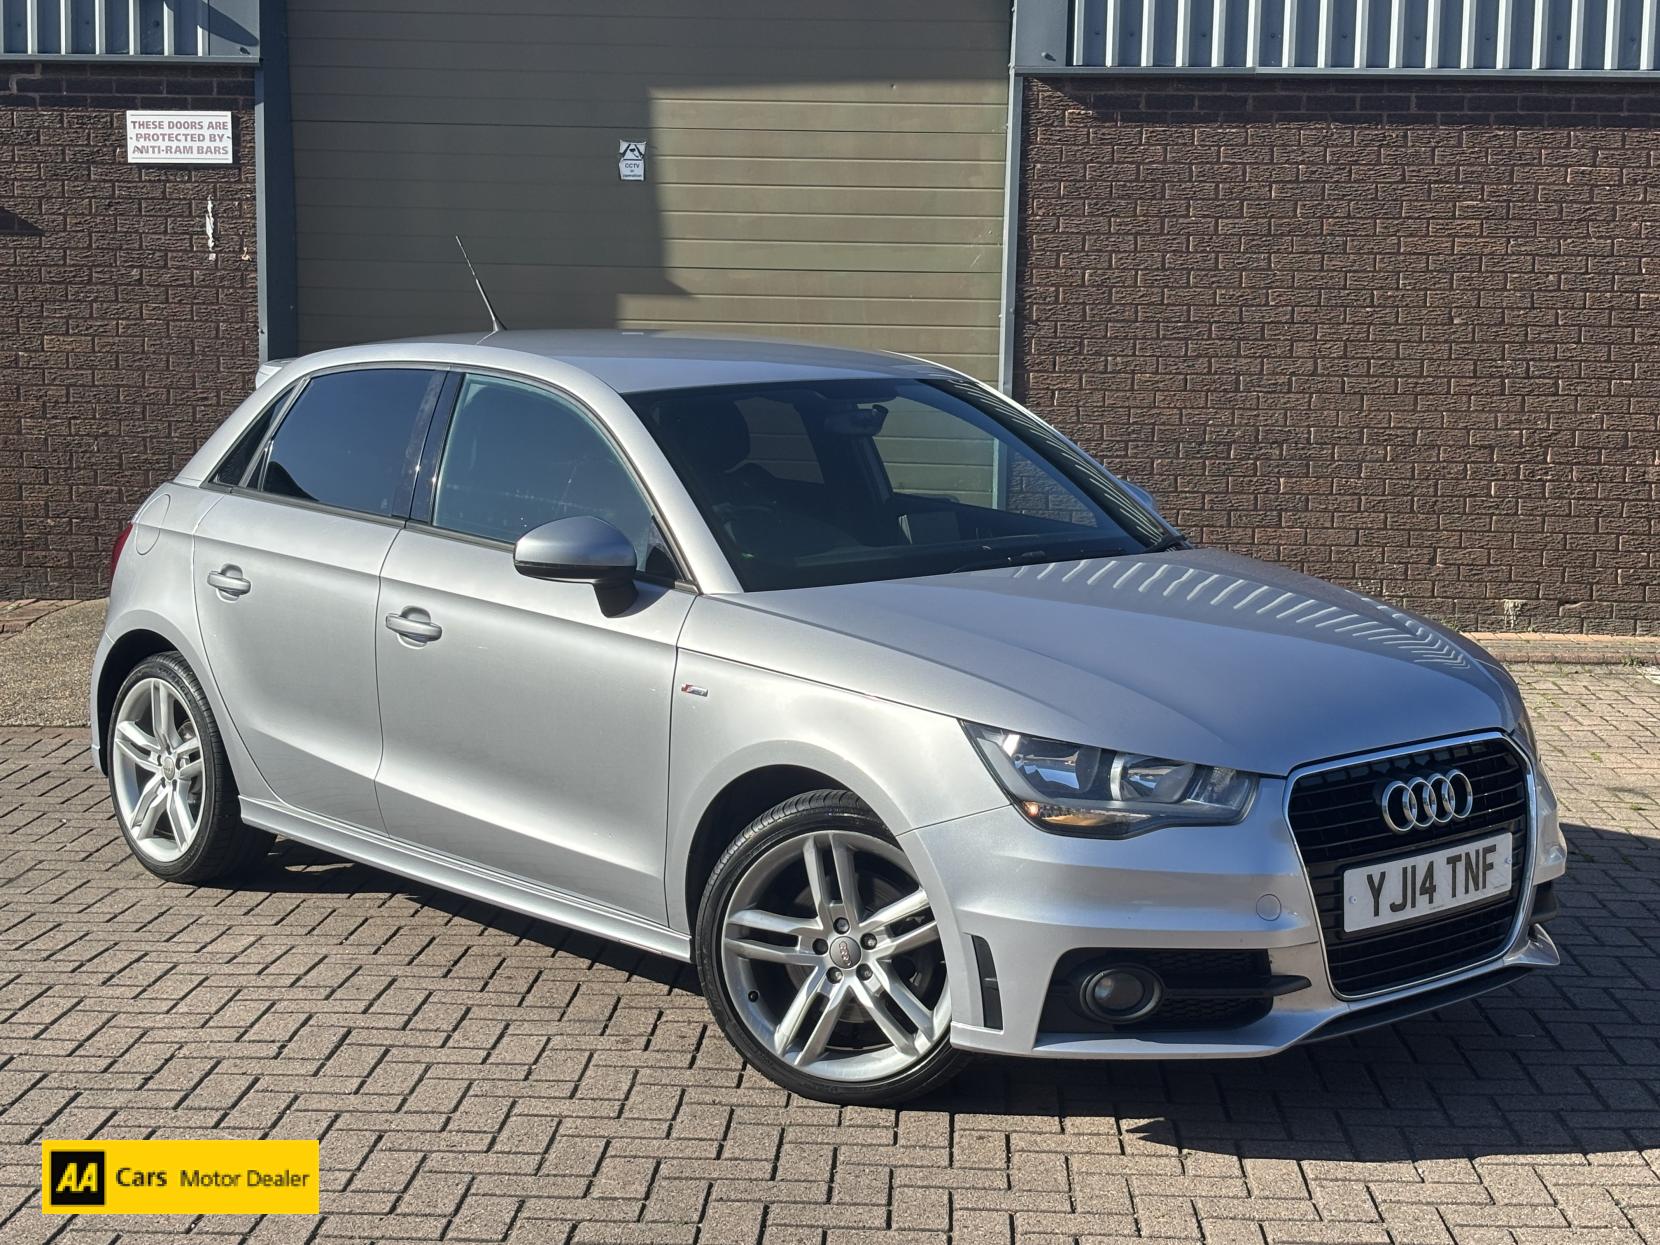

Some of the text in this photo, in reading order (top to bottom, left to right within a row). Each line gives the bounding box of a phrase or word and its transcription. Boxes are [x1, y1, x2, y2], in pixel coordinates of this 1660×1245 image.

[130, 120, 229, 131] THESE DOORS ARE
[135, 132, 225, 143] PROTECTED BY
[132, 145, 229, 155] ANTI-RAM BARS
[1366, 844, 1497, 918] YJ14 TNF
